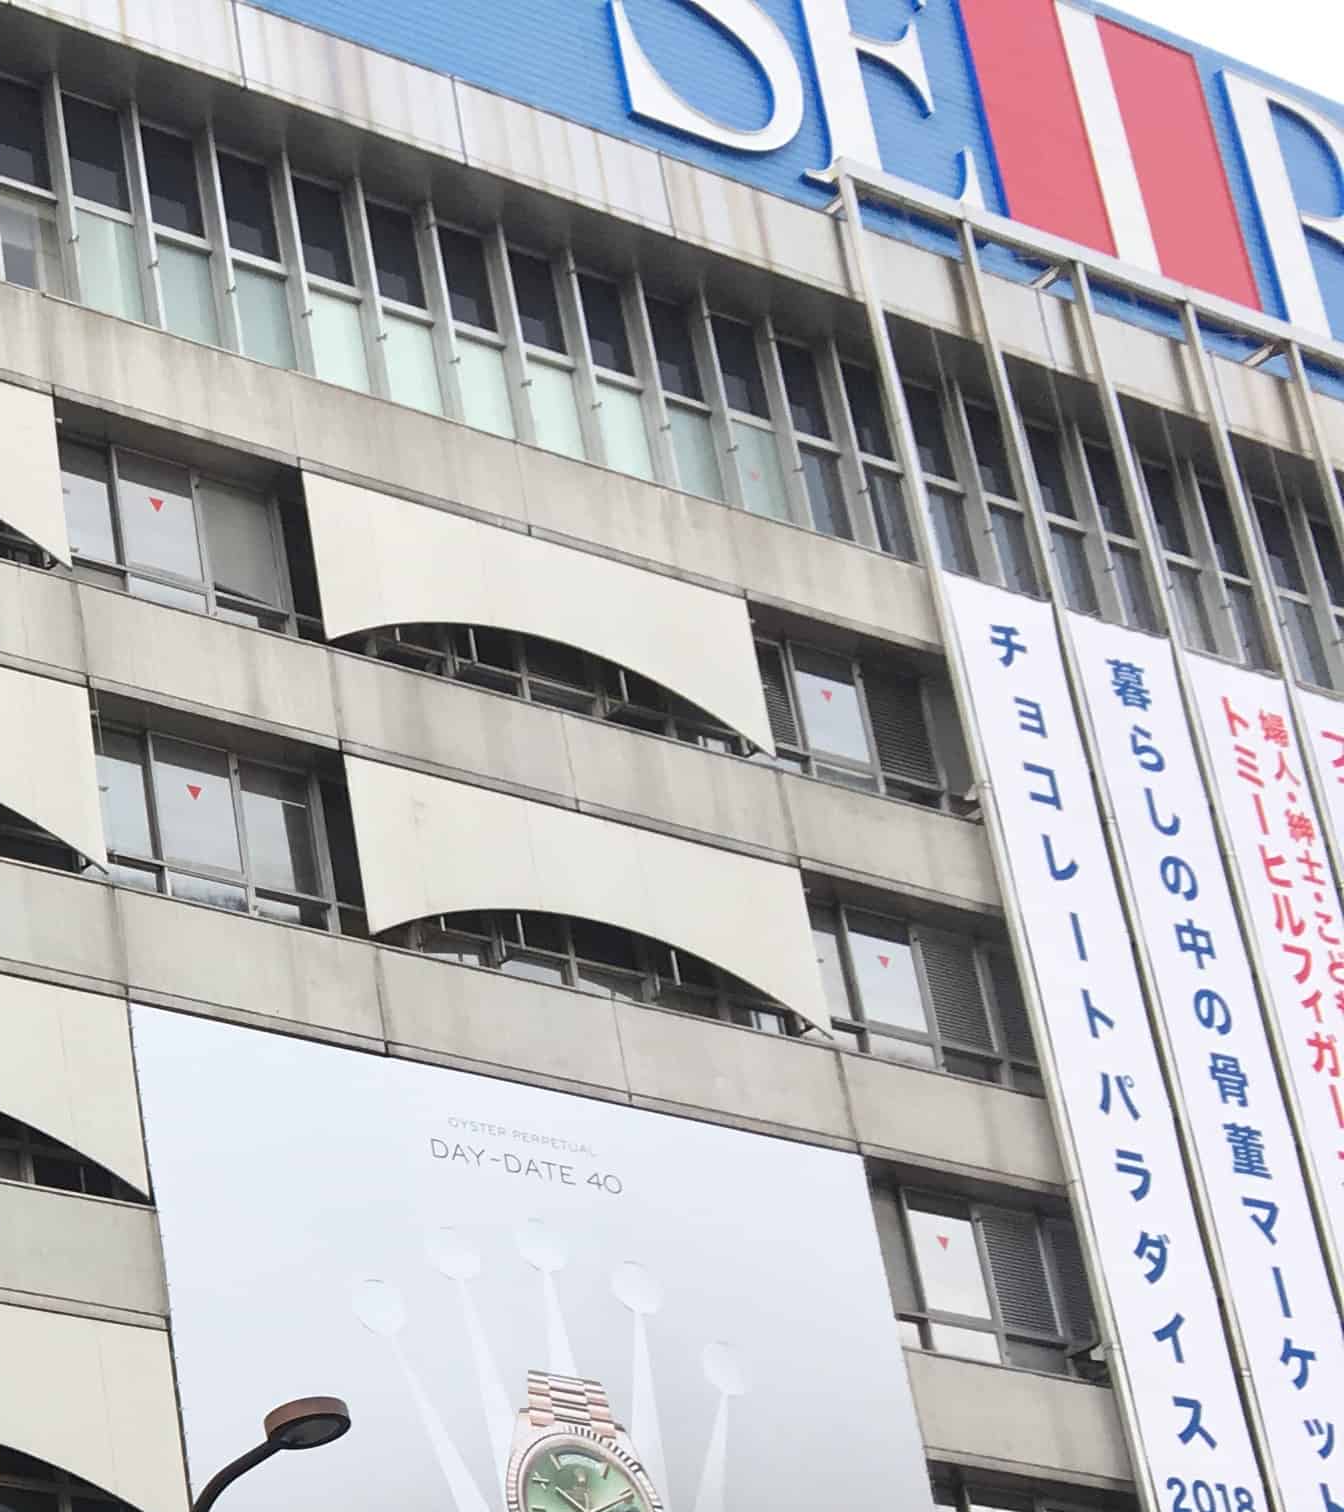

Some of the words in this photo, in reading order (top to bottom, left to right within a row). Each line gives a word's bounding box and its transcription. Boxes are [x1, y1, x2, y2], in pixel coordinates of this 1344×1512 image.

[989, 623, 1217, 1450] チョコレートパラダイス
[1221, 696, 1344, 1160] トミーヒルフィガー
[430, 1138, 577, 1186] DAY-DATE
[586, 1172, 624, 1195] 40
[447, 1116, 507, 1137] OYSTER
[511, 1129, 601, 1158] PERPETUAL
